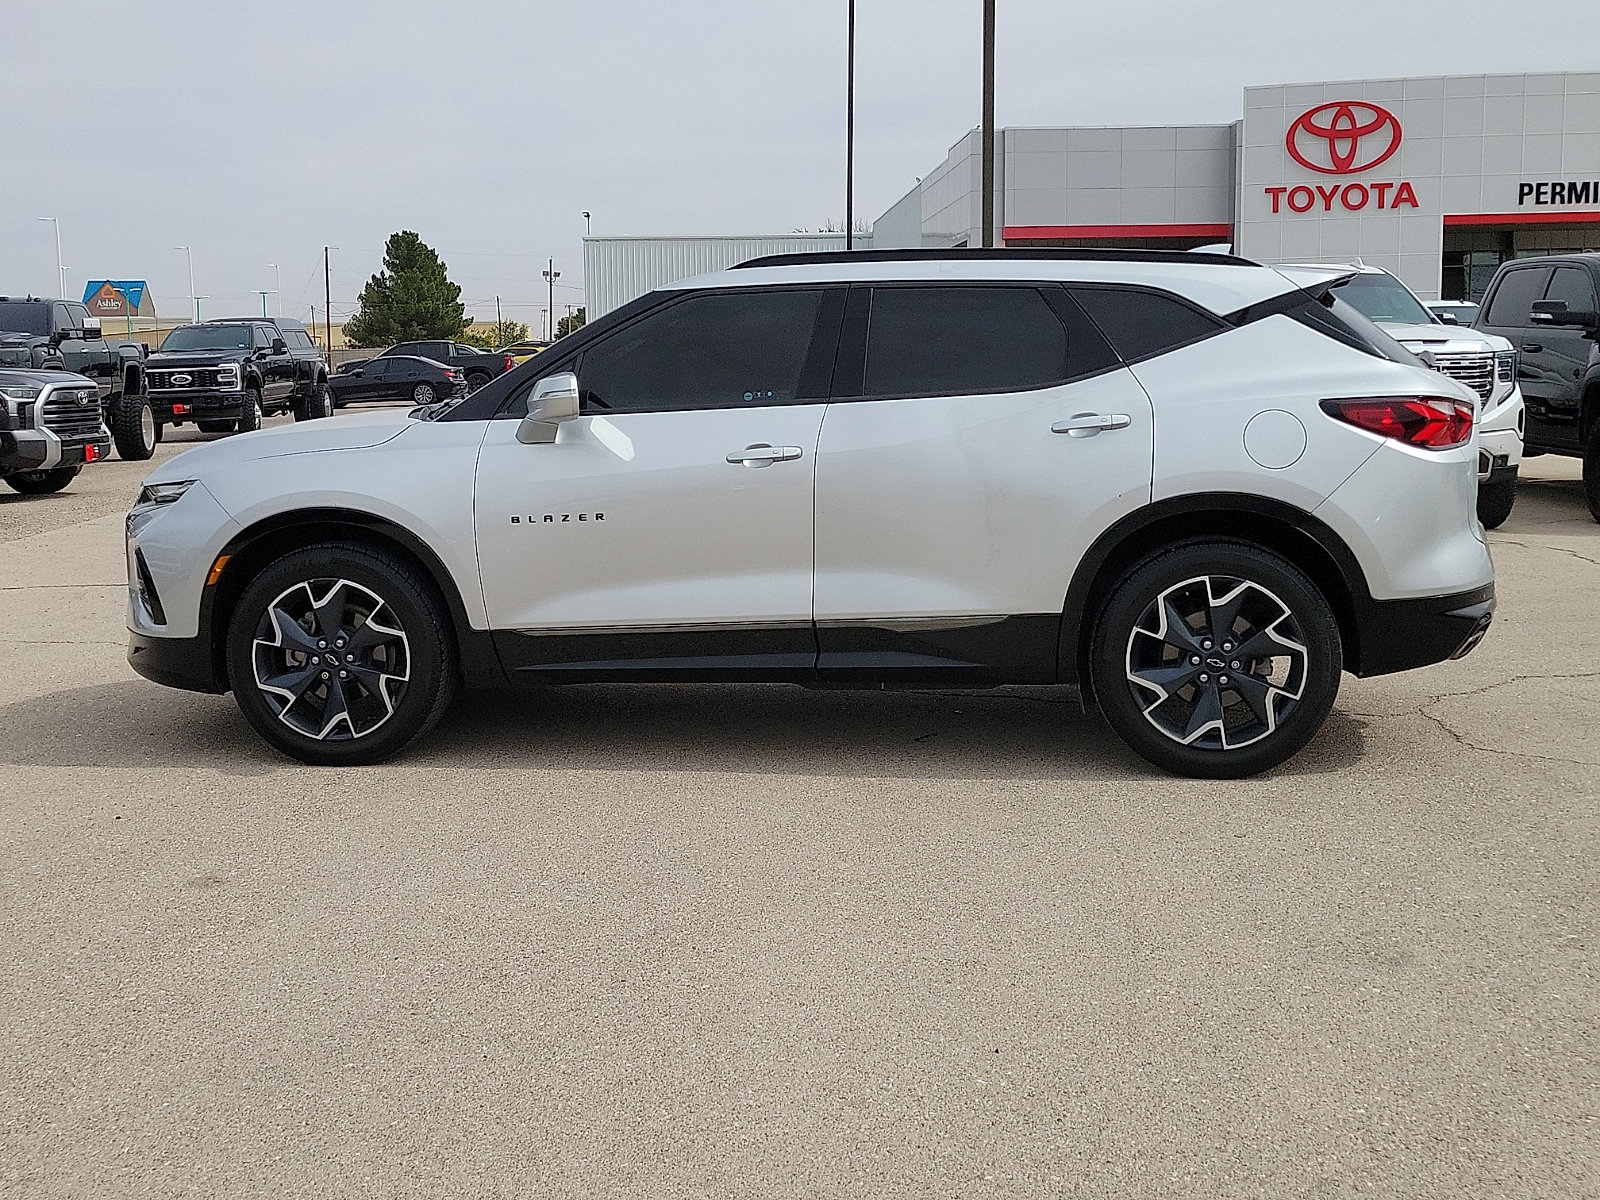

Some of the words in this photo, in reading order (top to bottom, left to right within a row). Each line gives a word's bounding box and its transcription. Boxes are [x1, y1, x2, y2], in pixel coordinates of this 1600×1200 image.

[1265, 182, 1420, 213] TOYOTA
[1518, 181, 1600, 206] PERMI
[96, 299, 122, 309] Ashley
[510, 512, 605, 524] BLAZER
